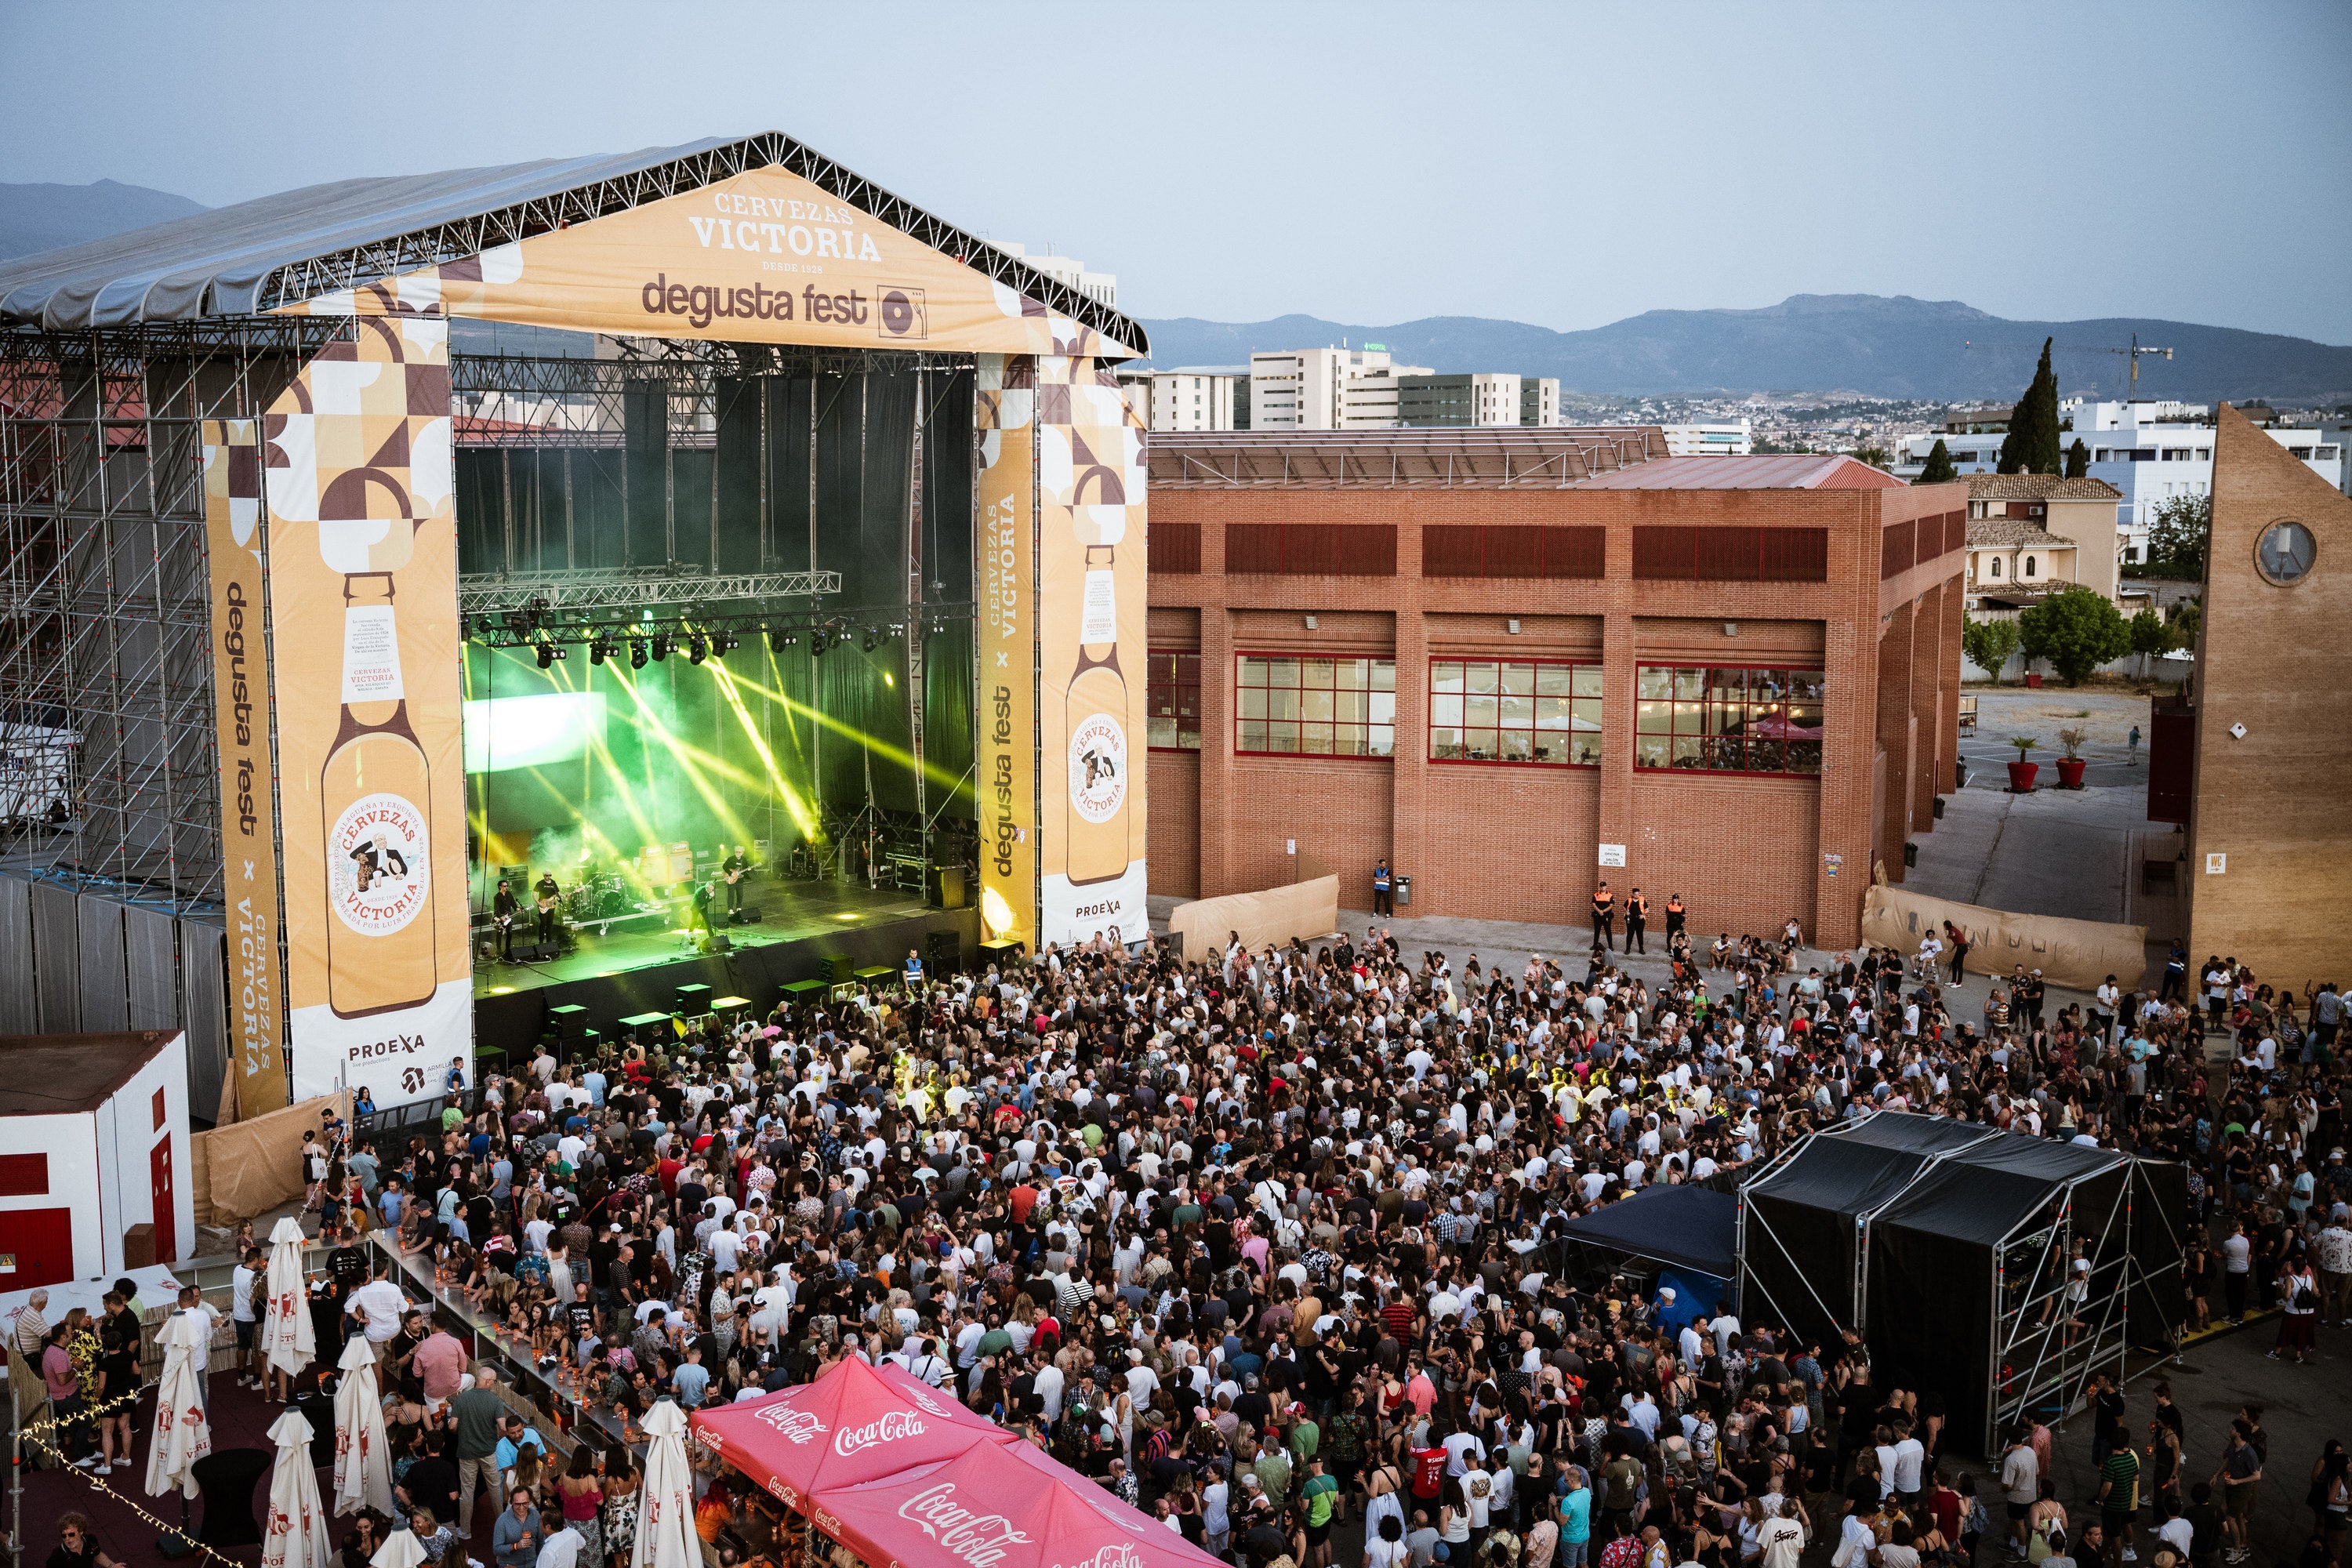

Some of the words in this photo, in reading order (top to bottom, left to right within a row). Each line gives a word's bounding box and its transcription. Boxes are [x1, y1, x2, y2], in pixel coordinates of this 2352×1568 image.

[714, 192, 855, 226] CERVEZAS
[688, 216, 882, 263] VICTORIA
[763, 261, 798, 274] DESDE
[801, 264, 823, 275] 1928
[641, 273, 794, 329] degusta
[802, 283, 868, 325] fest
[988, 505, 1000, 626] CERVEZAS
[1000, 493, 1017, 639] VICTORIA
[225, 582, 253, 747] degusta
[350, 673, 394, 684] VICTORIA
[993, 685, 1011, 746] fest
[1076, 726, 1120, 757] CERVEZAS
[238, 757, 258, 837] fest
[993, 754, 1018, 877] degusta
[1079, 784, 1120, 811] VICTORIA
[342, 810, 416, 851] CERVEZAS
[2211, 855, 2222, 867] WC
[347, 884, 418, 920] VICTORIA
[1076, 899, 1121, 918] PROEXA
[383, 917, 402, 928] LUIS
[238, 897, 259, 1078] VICTORIA
[256, 914, 270, 1070] CERVEZAS
[349, 1034, 425, 1061] PROEXA
[362, 1056, 390, 1066] productions
[427, 1061, 452, 1072] ARMILLA
[754, 1400, 830, 1444] Coca-Cola
[835, 1410, 926, 1457] Coca-Cola
[768, 1475, 797, 1508] Coca-Cola
[815, 1508, 842, 1537] Coca-Cola
[898, 1483, 1036, 1568] Coca-Cola
